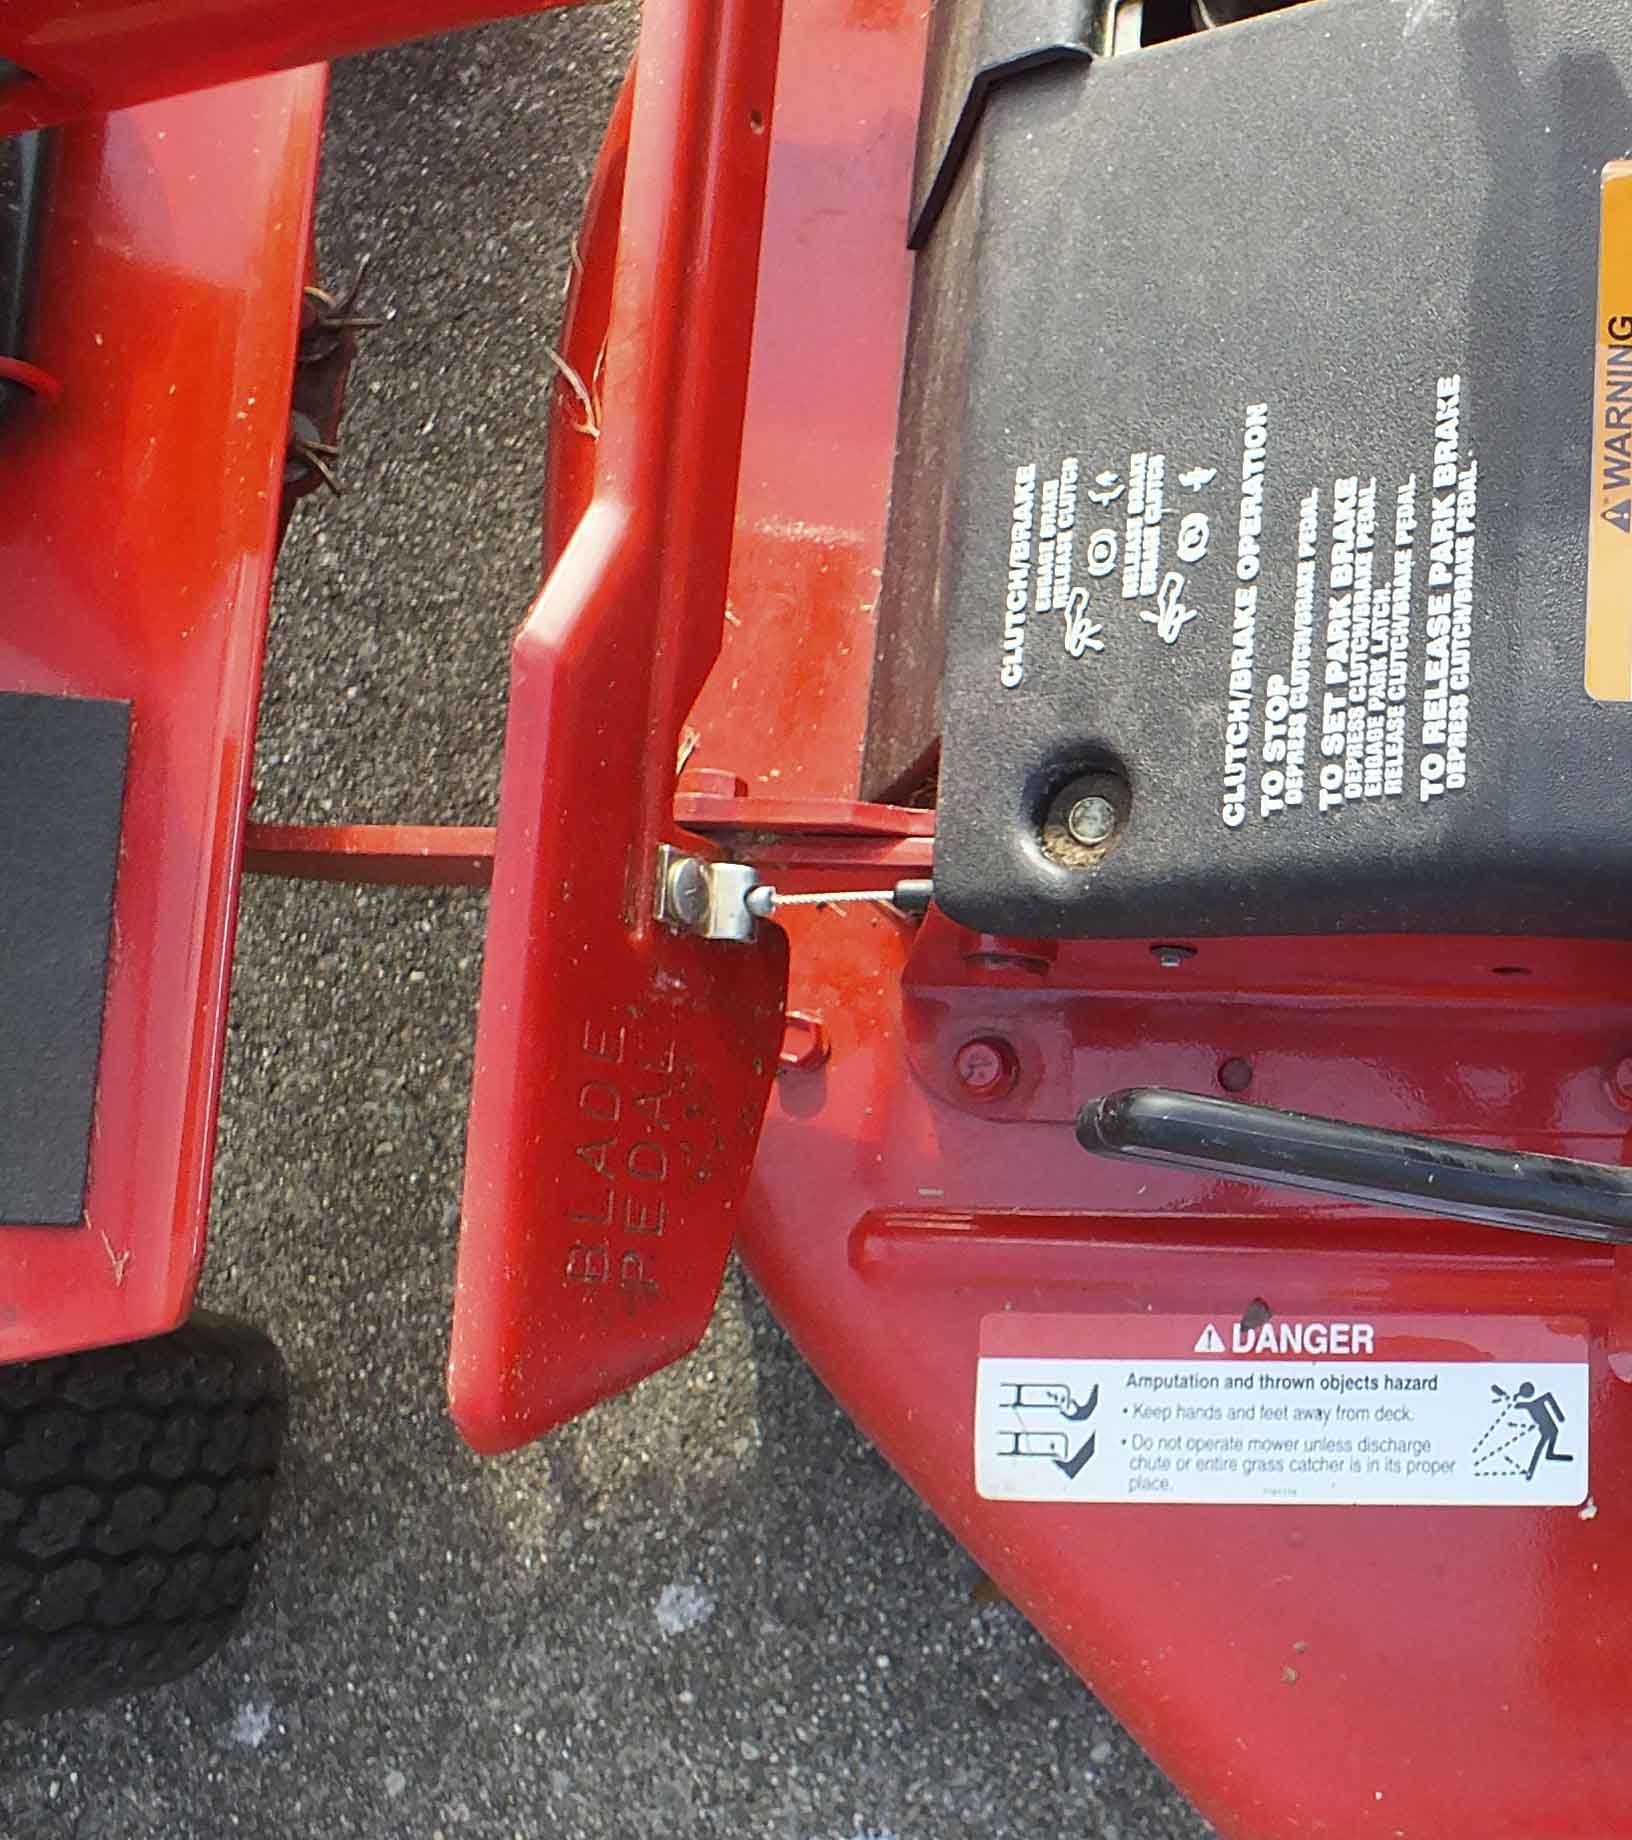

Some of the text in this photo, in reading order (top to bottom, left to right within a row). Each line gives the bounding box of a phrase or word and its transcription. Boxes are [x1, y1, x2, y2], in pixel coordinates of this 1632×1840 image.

[1001, 464, 1036, 687] CLUTCH/BRAKE
[1222, 403, 1268, 826] CLUTCH/BRAKE OPERATION
[1371, 582, 1392, 652] LATCH.
[1420, 374, 1461, 801] TO RELEASE PARK BRAKE
[1449, 537, 1475, 689] CLUTCH/BRAKE
[1320, 476, 1358, 810] TO SET PARK BRAKE
[1348, 553, 1373, 702] CLUTCH/BRAKE
[1387, 549, 1413, 700] CLUTCH/BRAKE
[1368, 657, 1388, 711] PARK
[1261, 674, 1290, 817] TO STOP
[1285, 713, 1307, 804] DEPRESS
[1345, 706, 1366, 798] DEPRESS
[1384, 704, 1405, 794] RELEASE
[1447, 694, 1468, 787] DEPRESS
[564, 1018, 627, 1283] BLADE
[619, 1038, 677, 1293] PEDAL
[1126, 1373, 1438, 1394] Amputation and thrown objects hazard
[1231, 1322, 1375, 1355] DANGER
[1132, 1403, 1172, 1422] Keep
[1176, 1403, 1222, 1420] hands
[1226, 1404, 1255, 1421] and
[1260, 1404, 1288, 1421] feet
[1293, 1408, 1332, 1425] away
[1336, 1404, 1370, 1422] from
[1132, 1435, 1431, 1457] Do not operate mower unless discharge
[1129, 1454, 1456, 1477] chute or entire grass catcher is in its proper
